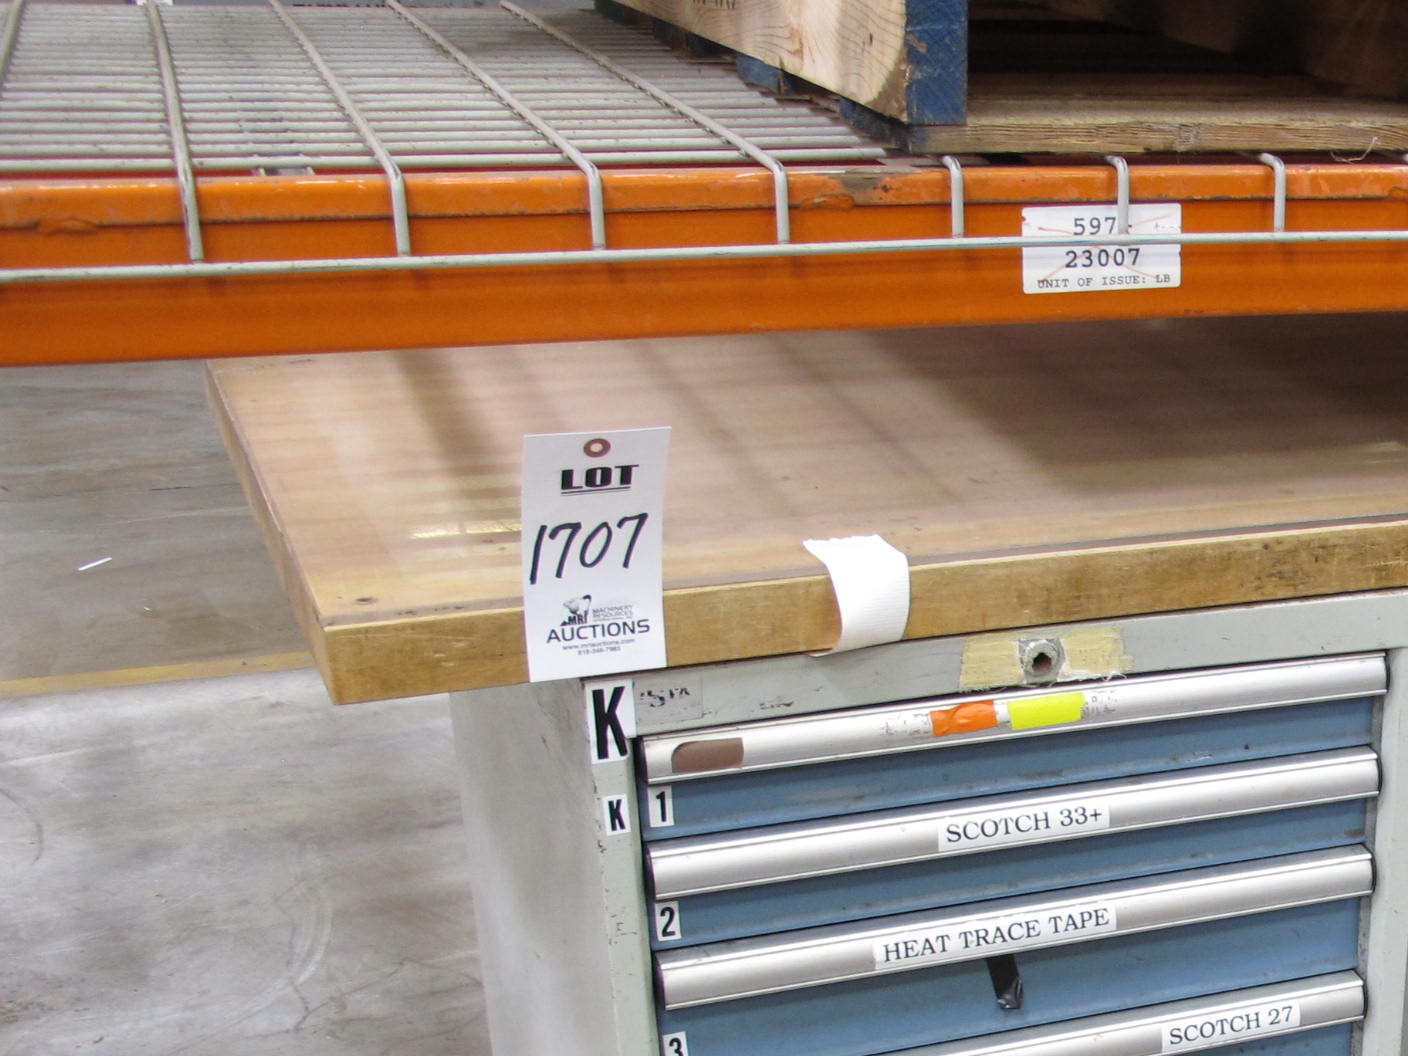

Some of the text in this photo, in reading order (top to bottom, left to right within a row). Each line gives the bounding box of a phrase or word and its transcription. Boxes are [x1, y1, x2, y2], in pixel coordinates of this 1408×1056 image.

[1065, 248, 1140, 268] 23007
[1038, 274, 1171, 288] UNIT OF ISSUE: LB
[560, 464, 639, 490] LOT
[529, 512, 649, 585] 1707
[546, 619, 650, 643] AUCTIONS
[592, 686, 628, 761] K
[608, 799, 626, 832] K
[655, 791, 667, 822] 1
[946, 806, 1103, 843] SCOTCH 33+
[660, 906, 676, 937] 2
[884, 908, 1110, 962] HEAT TRACE TAPE
[1169, 1006, 1294, 1045] SCOTCH 27
